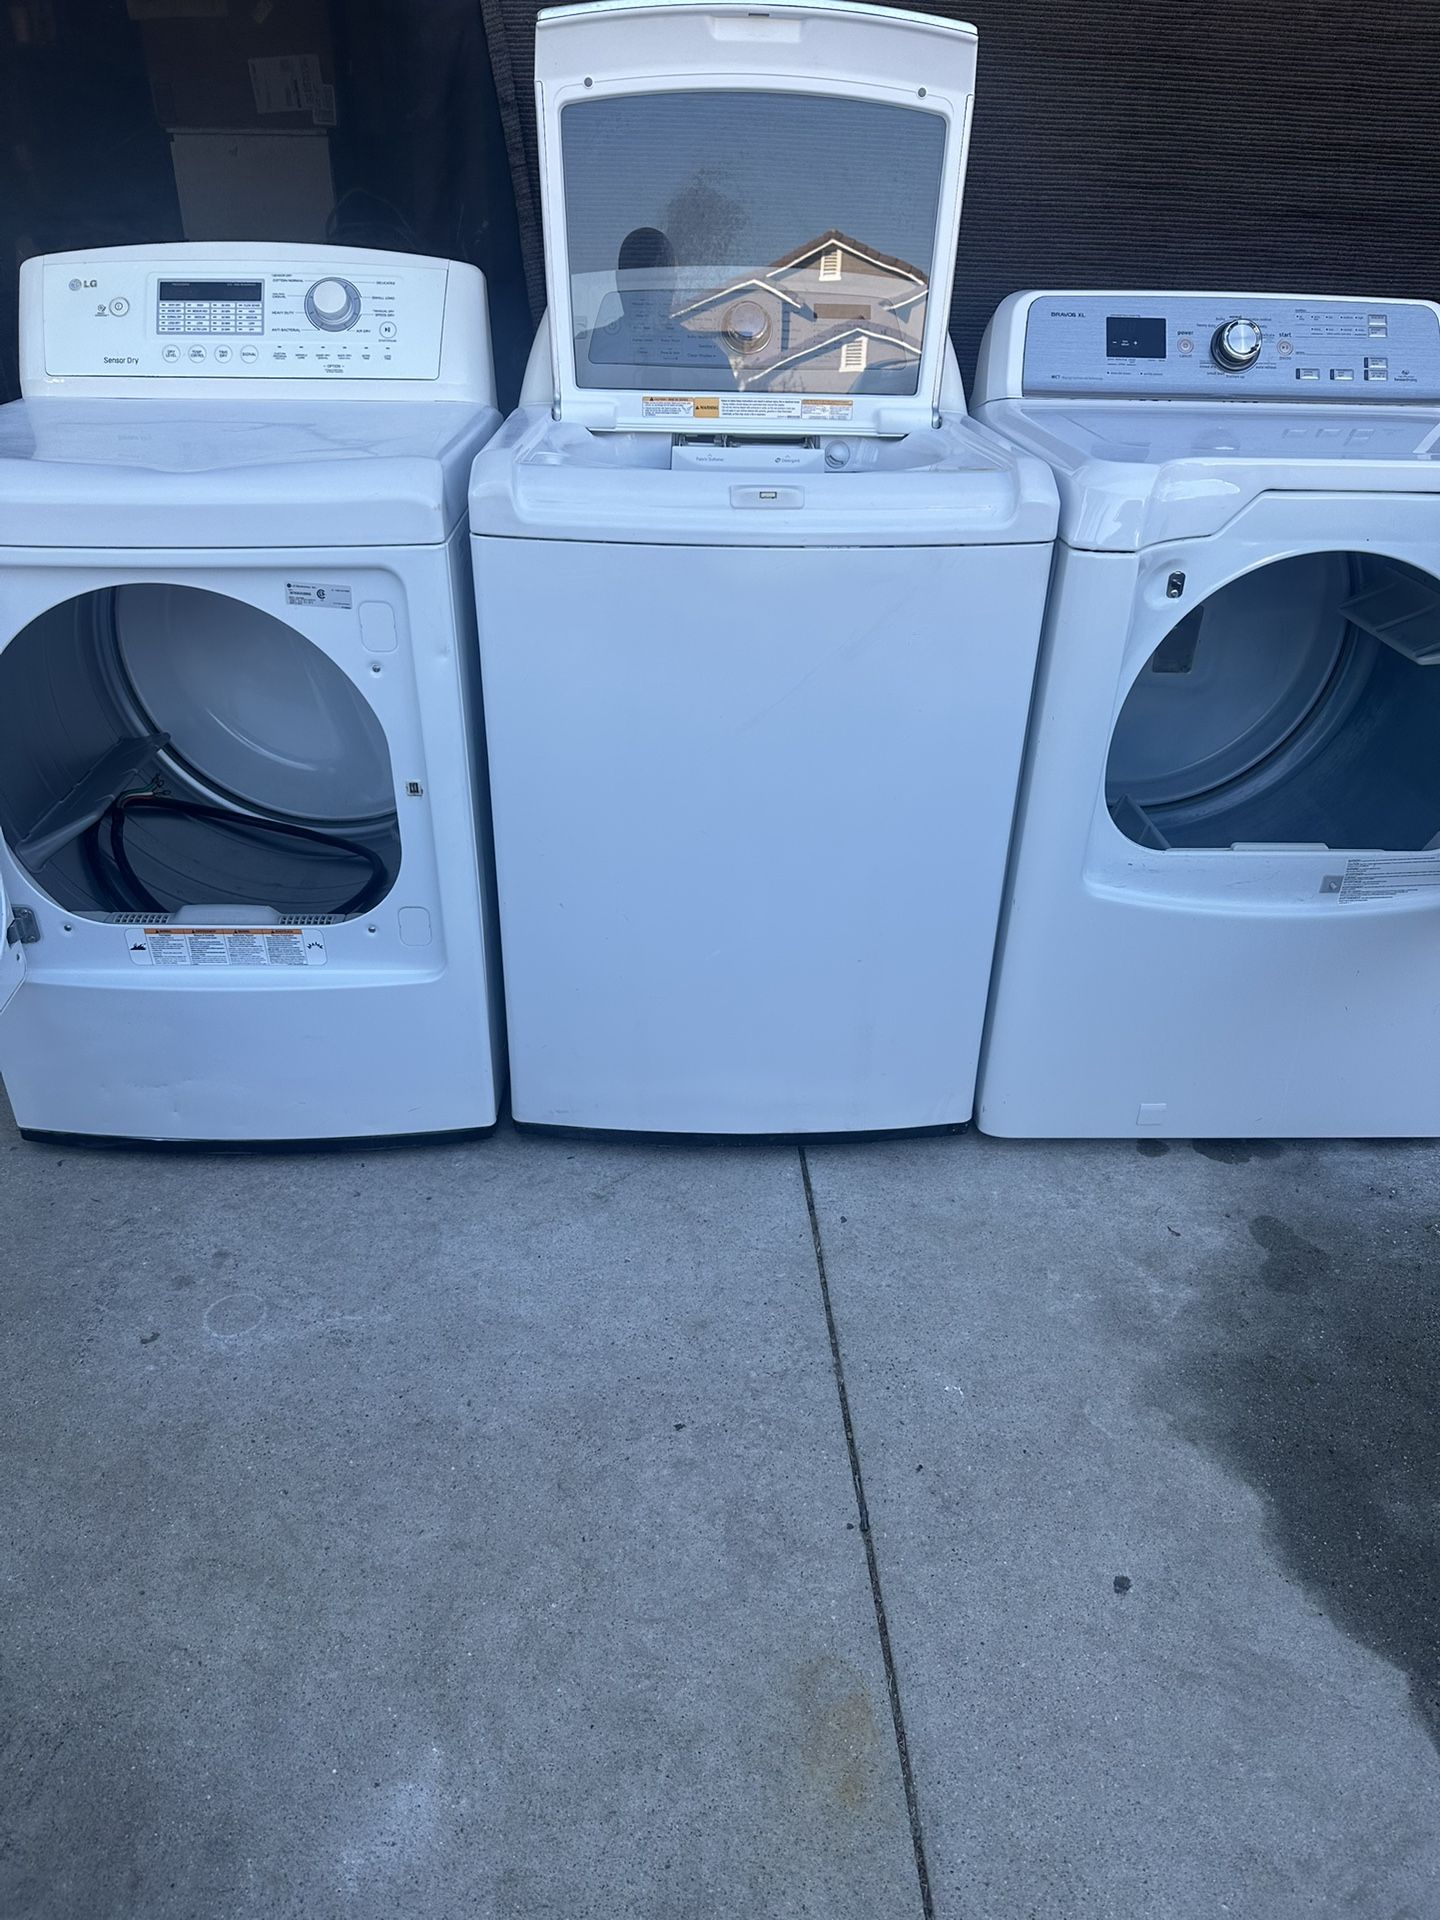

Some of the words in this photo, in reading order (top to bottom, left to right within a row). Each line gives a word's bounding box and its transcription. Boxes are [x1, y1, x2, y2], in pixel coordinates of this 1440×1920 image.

[83, 280, 98, 288] LG
[103, 356, 126, 364] Sensor
[127, 357, 140, 366] Dry
